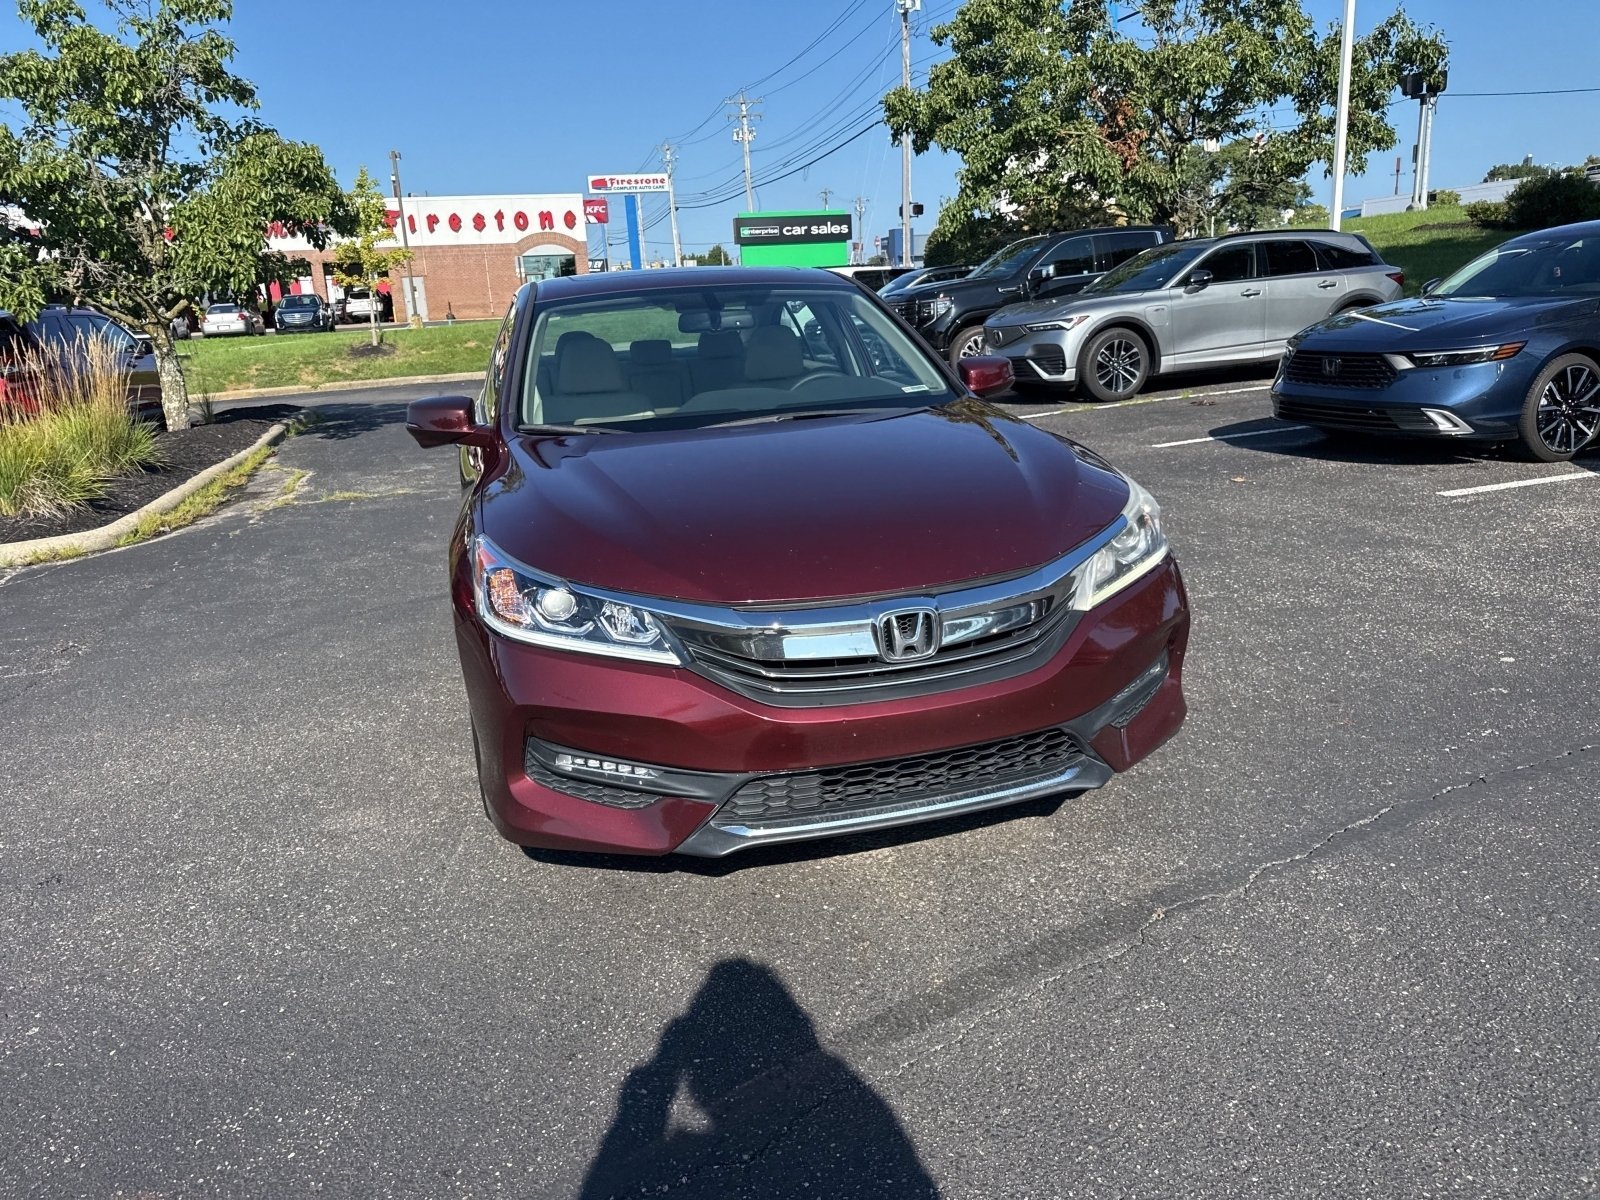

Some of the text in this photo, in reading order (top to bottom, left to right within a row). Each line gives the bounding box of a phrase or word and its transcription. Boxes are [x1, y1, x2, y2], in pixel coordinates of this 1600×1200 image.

[608, 177, 666, 187] Firestone
[585, 205, 606, 214] KFC
[782, 225, 808, 236] car
[810, 221, 849, 235] sales
